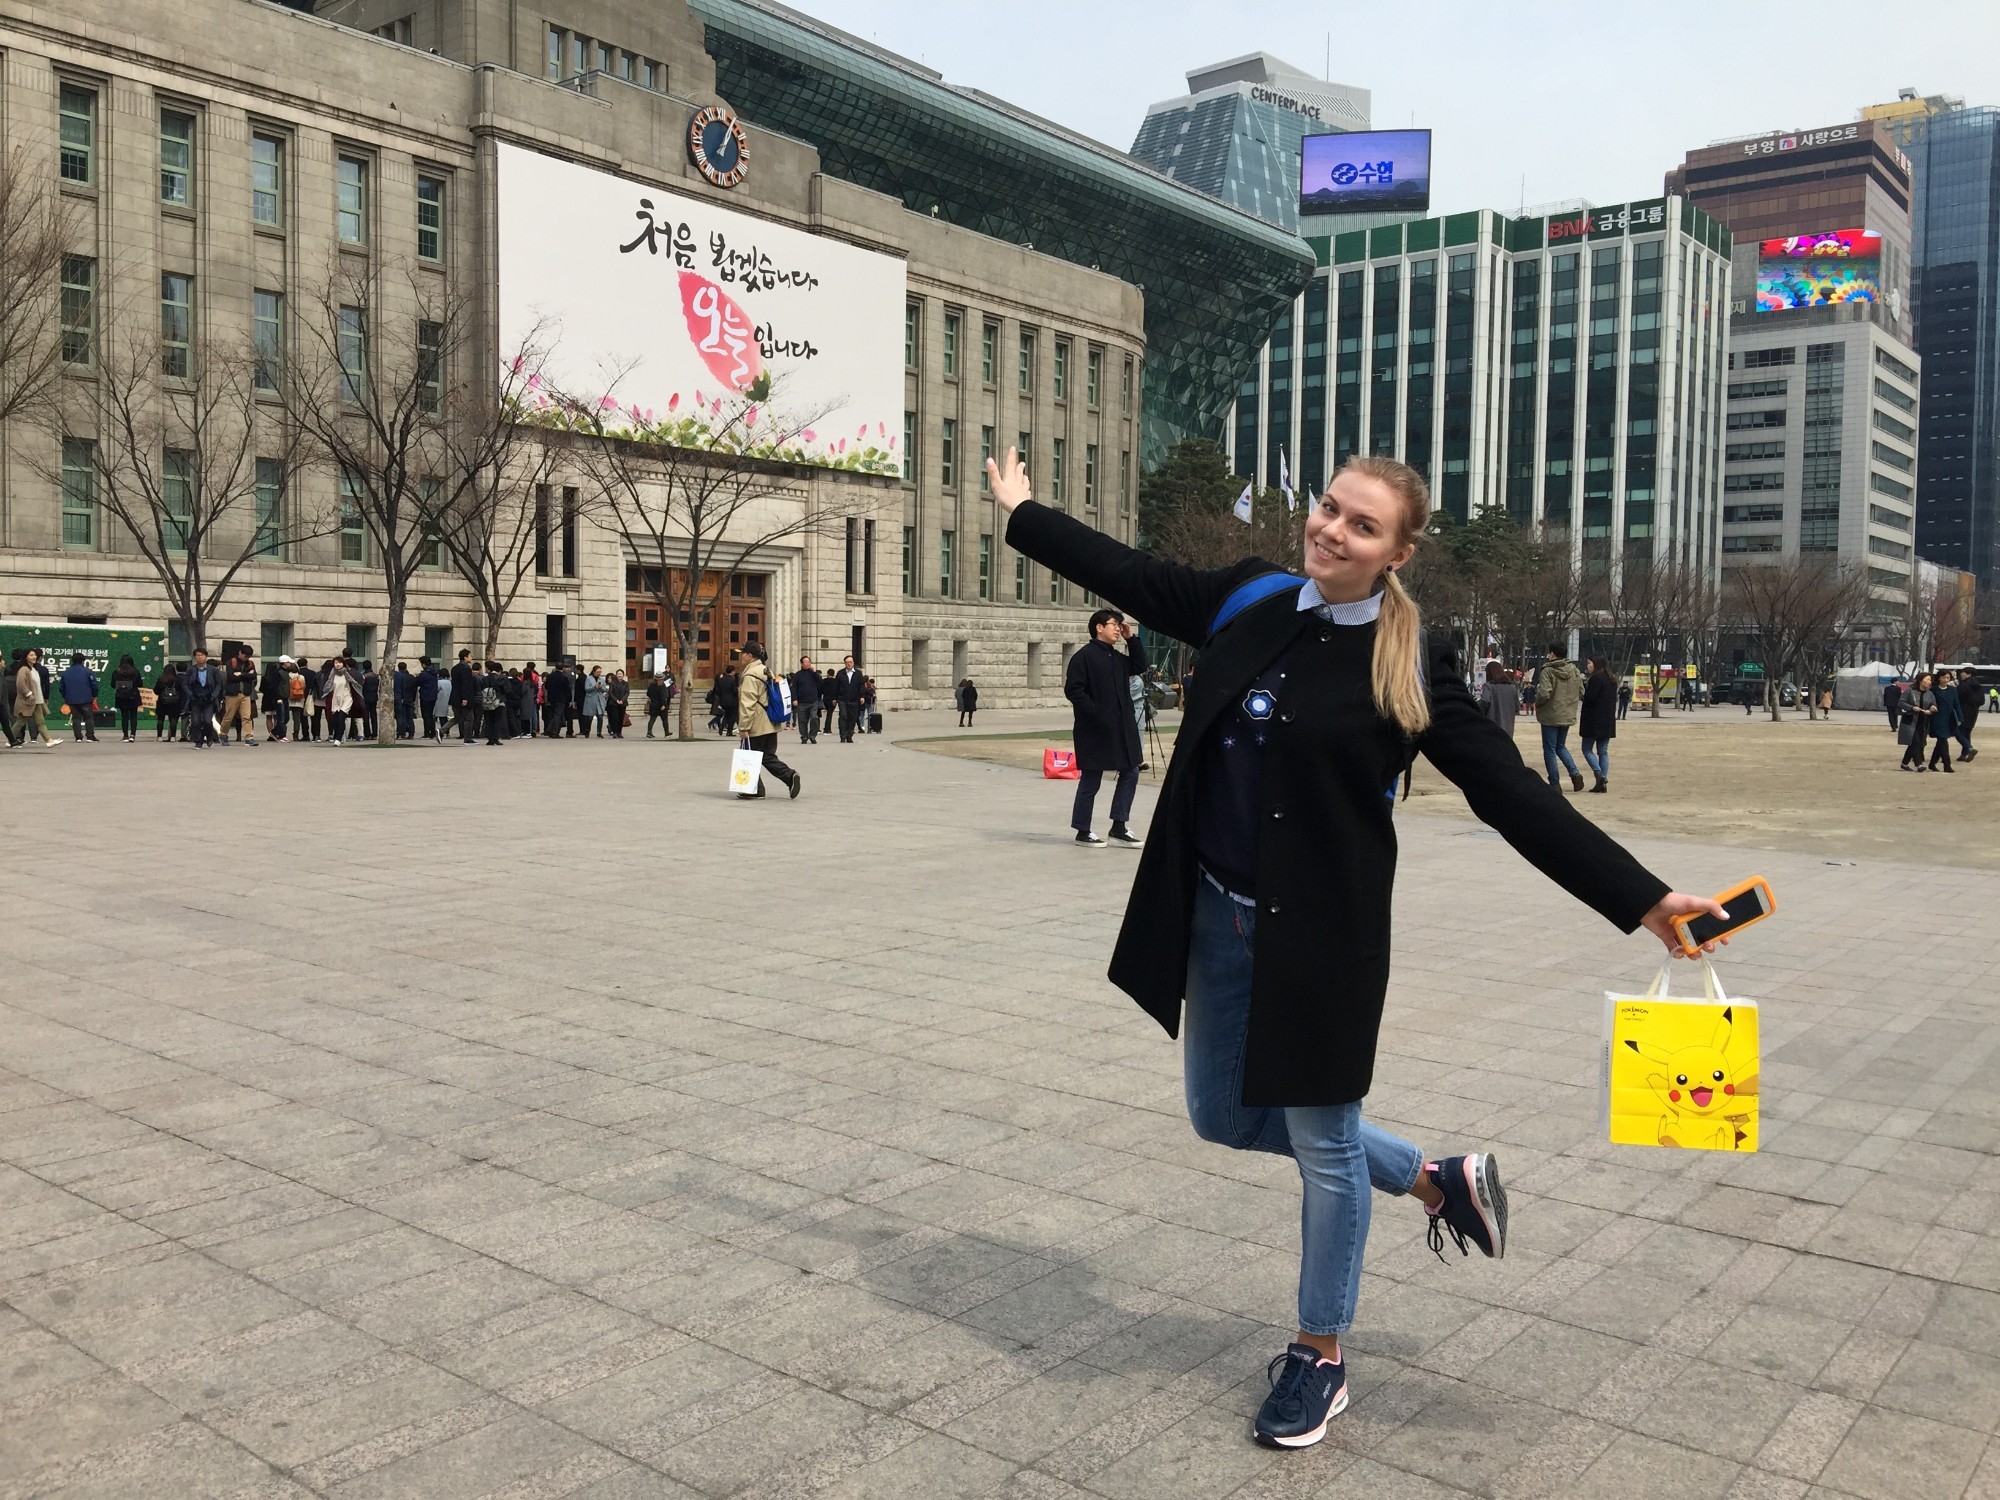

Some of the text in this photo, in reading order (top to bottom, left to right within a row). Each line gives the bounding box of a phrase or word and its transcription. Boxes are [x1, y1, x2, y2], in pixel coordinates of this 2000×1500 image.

[1251, 86, 1321, 120] CENTERPLACE
[1743, 126, 1858, 156] 부영 사랑으로
[1358, 161, 1394, 184] 수협
[619, 198, 697, 270] 처음
[1548, 205, 1665, 240] BNK 금융그룹
